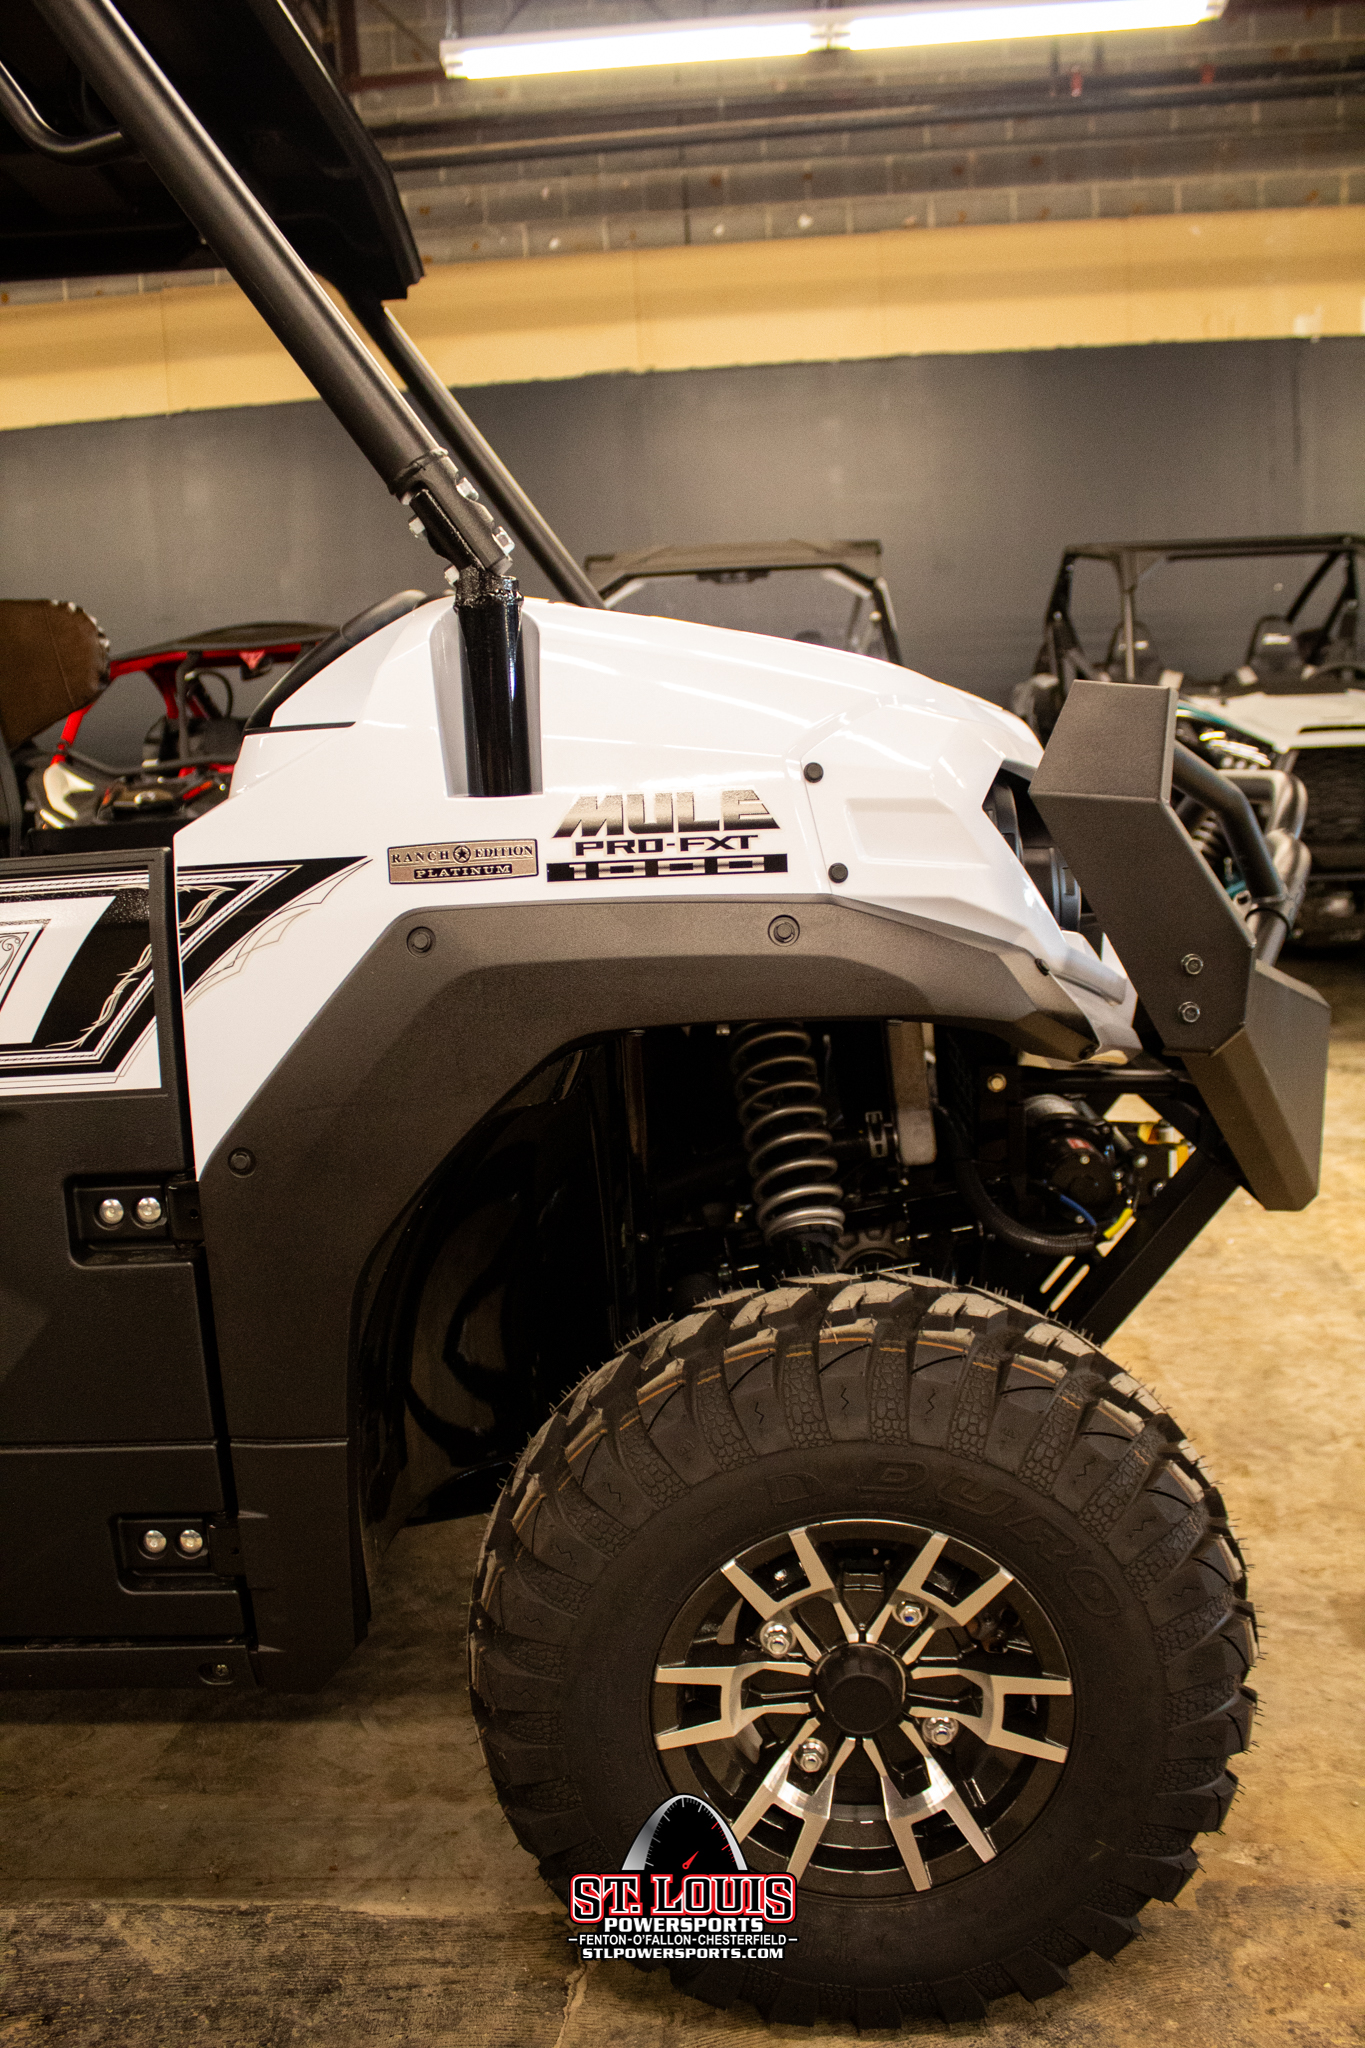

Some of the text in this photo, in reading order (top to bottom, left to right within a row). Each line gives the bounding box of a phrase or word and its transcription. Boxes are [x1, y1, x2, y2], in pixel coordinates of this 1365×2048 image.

[551, 789, 780, 838] MULE
[391, 845, 533, 864] RANCH EDITION
[574, 834, 759, 857] PRO-FXT
[415, 864, 511, 879] PLATINUM
[570, 856, 765, 879] 1000
